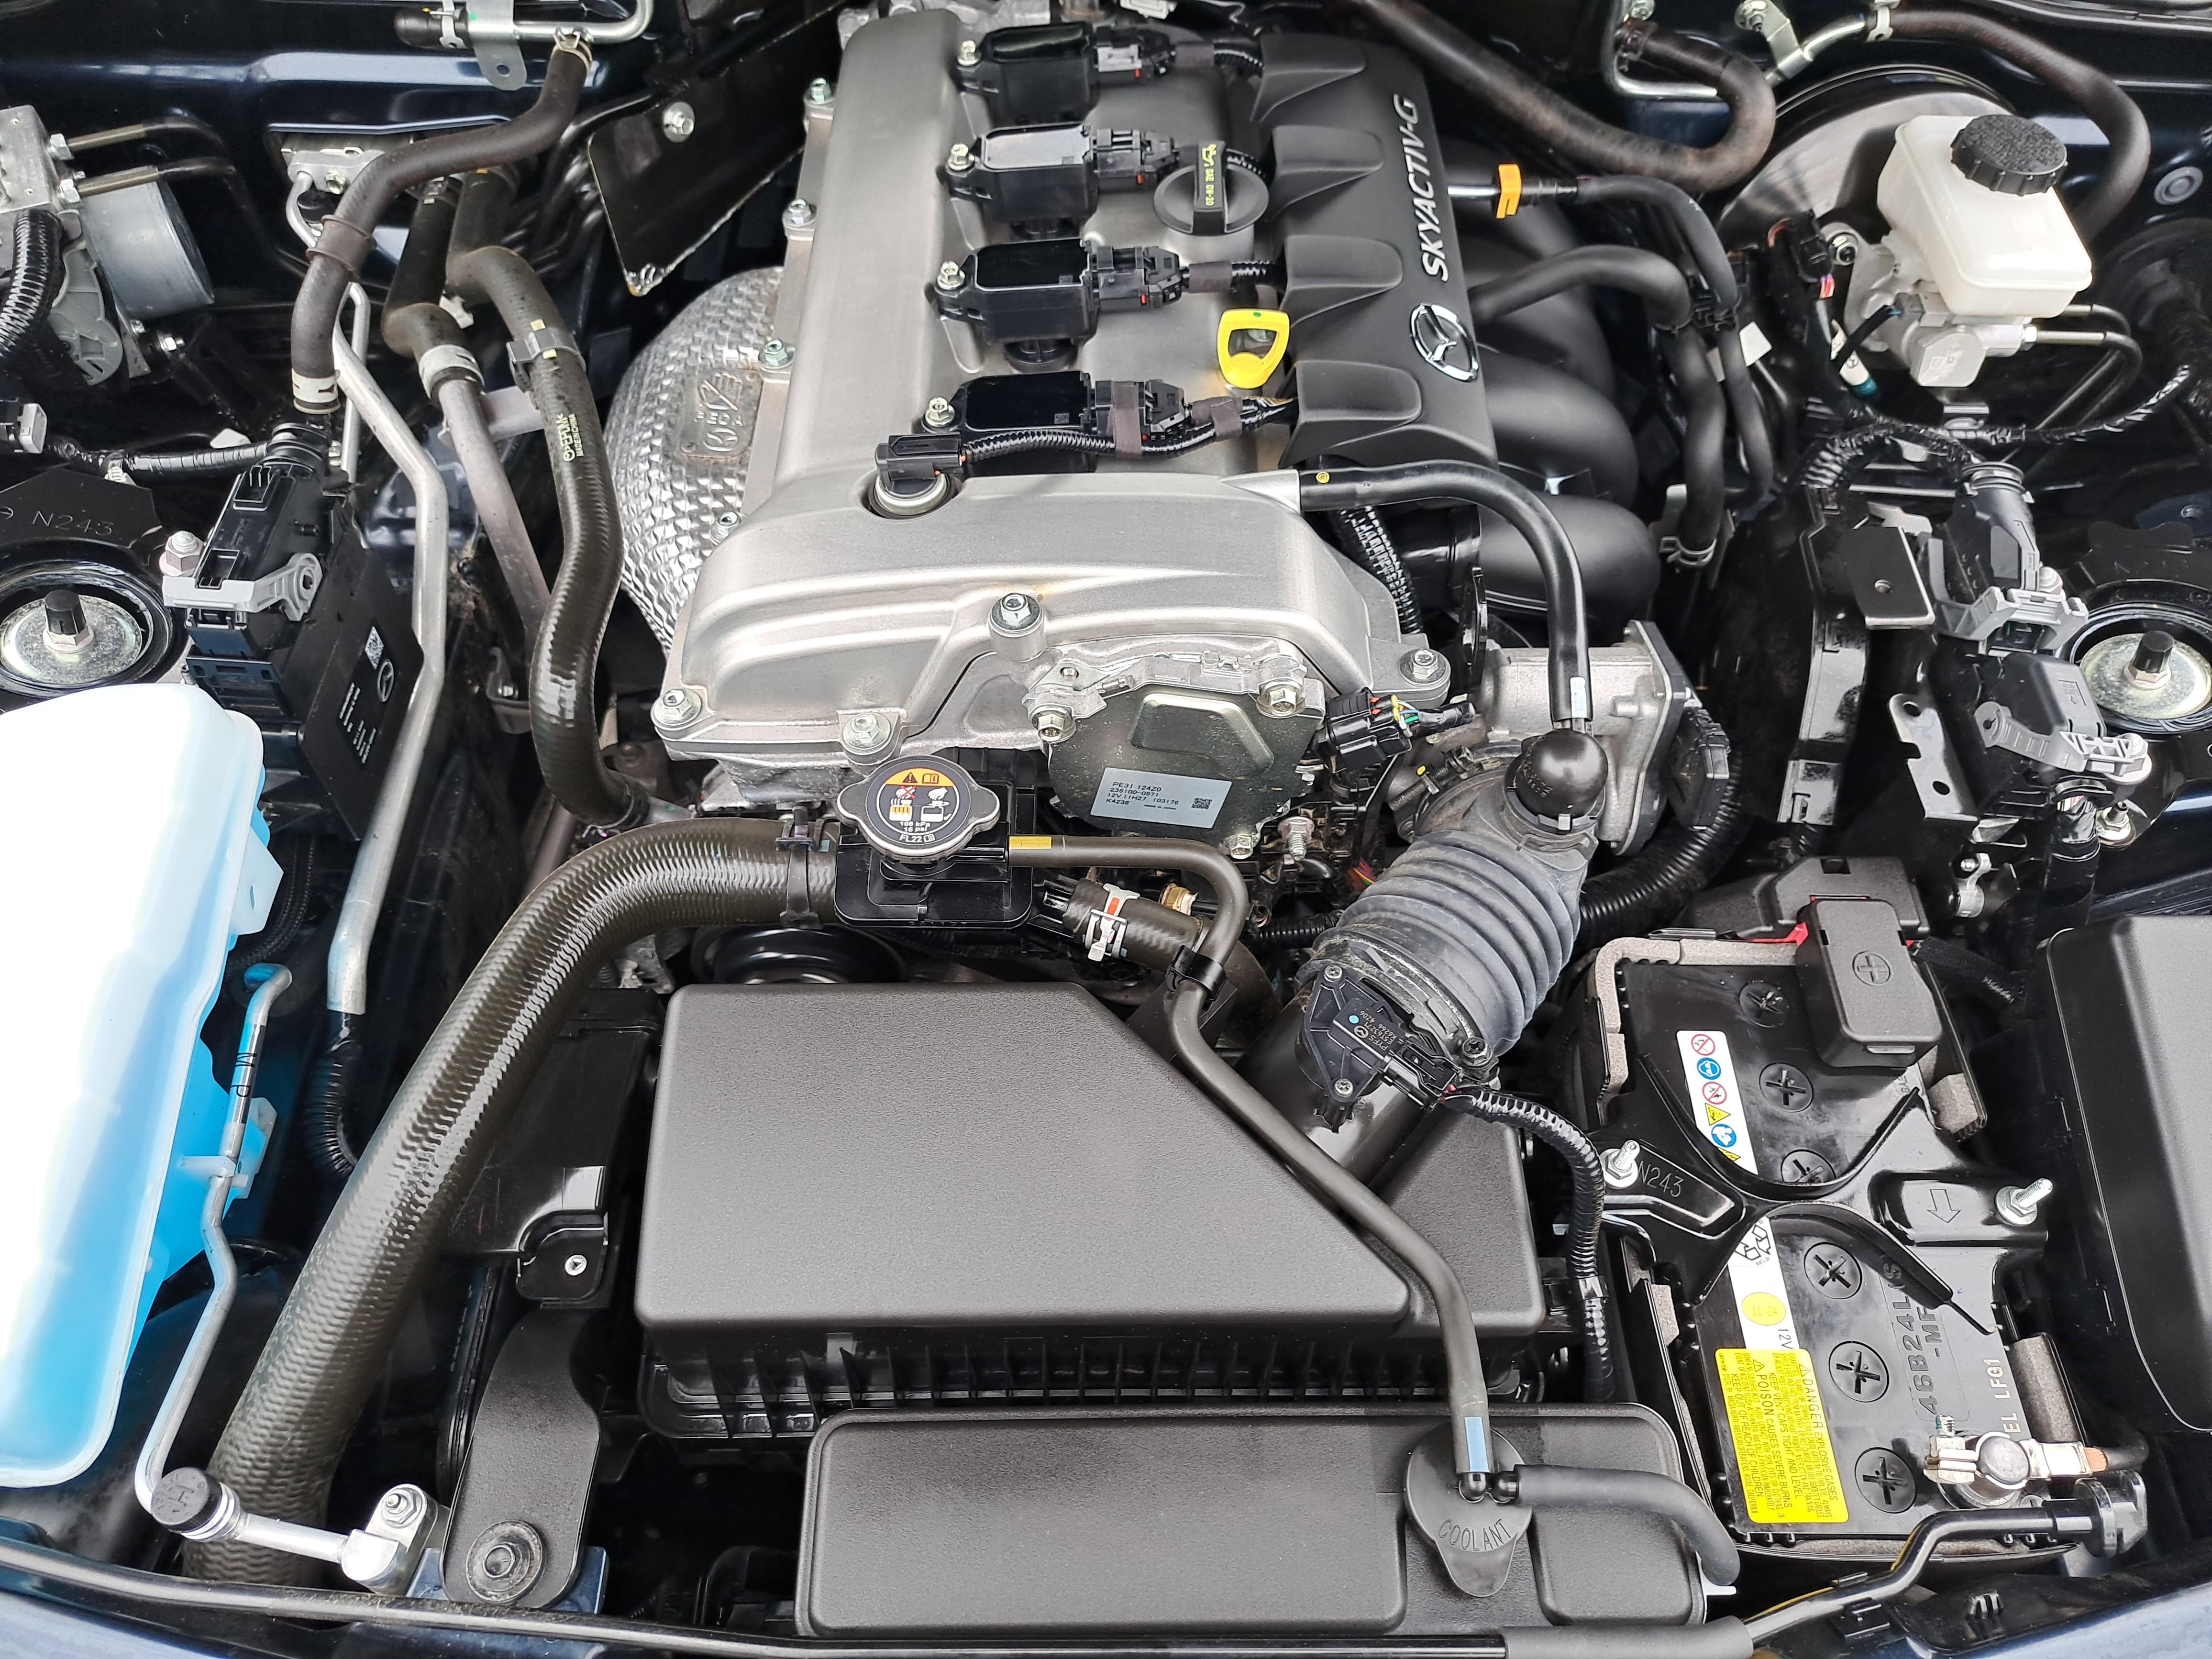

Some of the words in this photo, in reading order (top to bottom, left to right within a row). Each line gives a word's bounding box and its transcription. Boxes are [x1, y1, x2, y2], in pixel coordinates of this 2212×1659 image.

[1205, 169, 1215, 182] SAE
[1393, 93, 1449, 282] SKYACTIV-G
[32, 510, 115, 536] N243
[1109, 787, 1159, 797] 235100-0971
[899, 834, 923, 843] FL22
[1369, 1035, 1388, 1051] PYFS
[1638, 1160, 1685, 1197] N243
[1729, 1373, 1741, 1392] KEEP
[1767, 1372, 1779, 1390] KEEP
[1983, 1358, 2012, 1399] LFG1
[1734, 1394, 1745, 1408] OUT
[1755, 1374, 1775, 1415] POISON
[1771, 1393, 1784, 1411] VENT
[1737, 1410, 1747, 1420] OF
[1776, 1413, 1789, 1432] CAPS
[1740, 1422, 1753, 1446] REACH
[1764, 1418, 1780, 1448] CAUSES
[1801, 1379, 1824, 1428] DANGER
[1814, 1432, 1831, 1472] EXPLOSIVE
[1824, 1475, 1838, 1501] GASES
[1746, 1448, 1756, 1458] OF
[1781, 1435, 1794, 1456] TIGHT
[1771, 1450, 1787, 1480] SEVERE
[1786, 1458, 1798, 1473] AND
[1748, 1460, 1764, 1496] CHILDREN
[1790, 1475, 1804, 1498] LEVEL
[1779, 1482, 1793, 1507] BURNS
[1438, 1518, 1512, 1552] COOLANT
